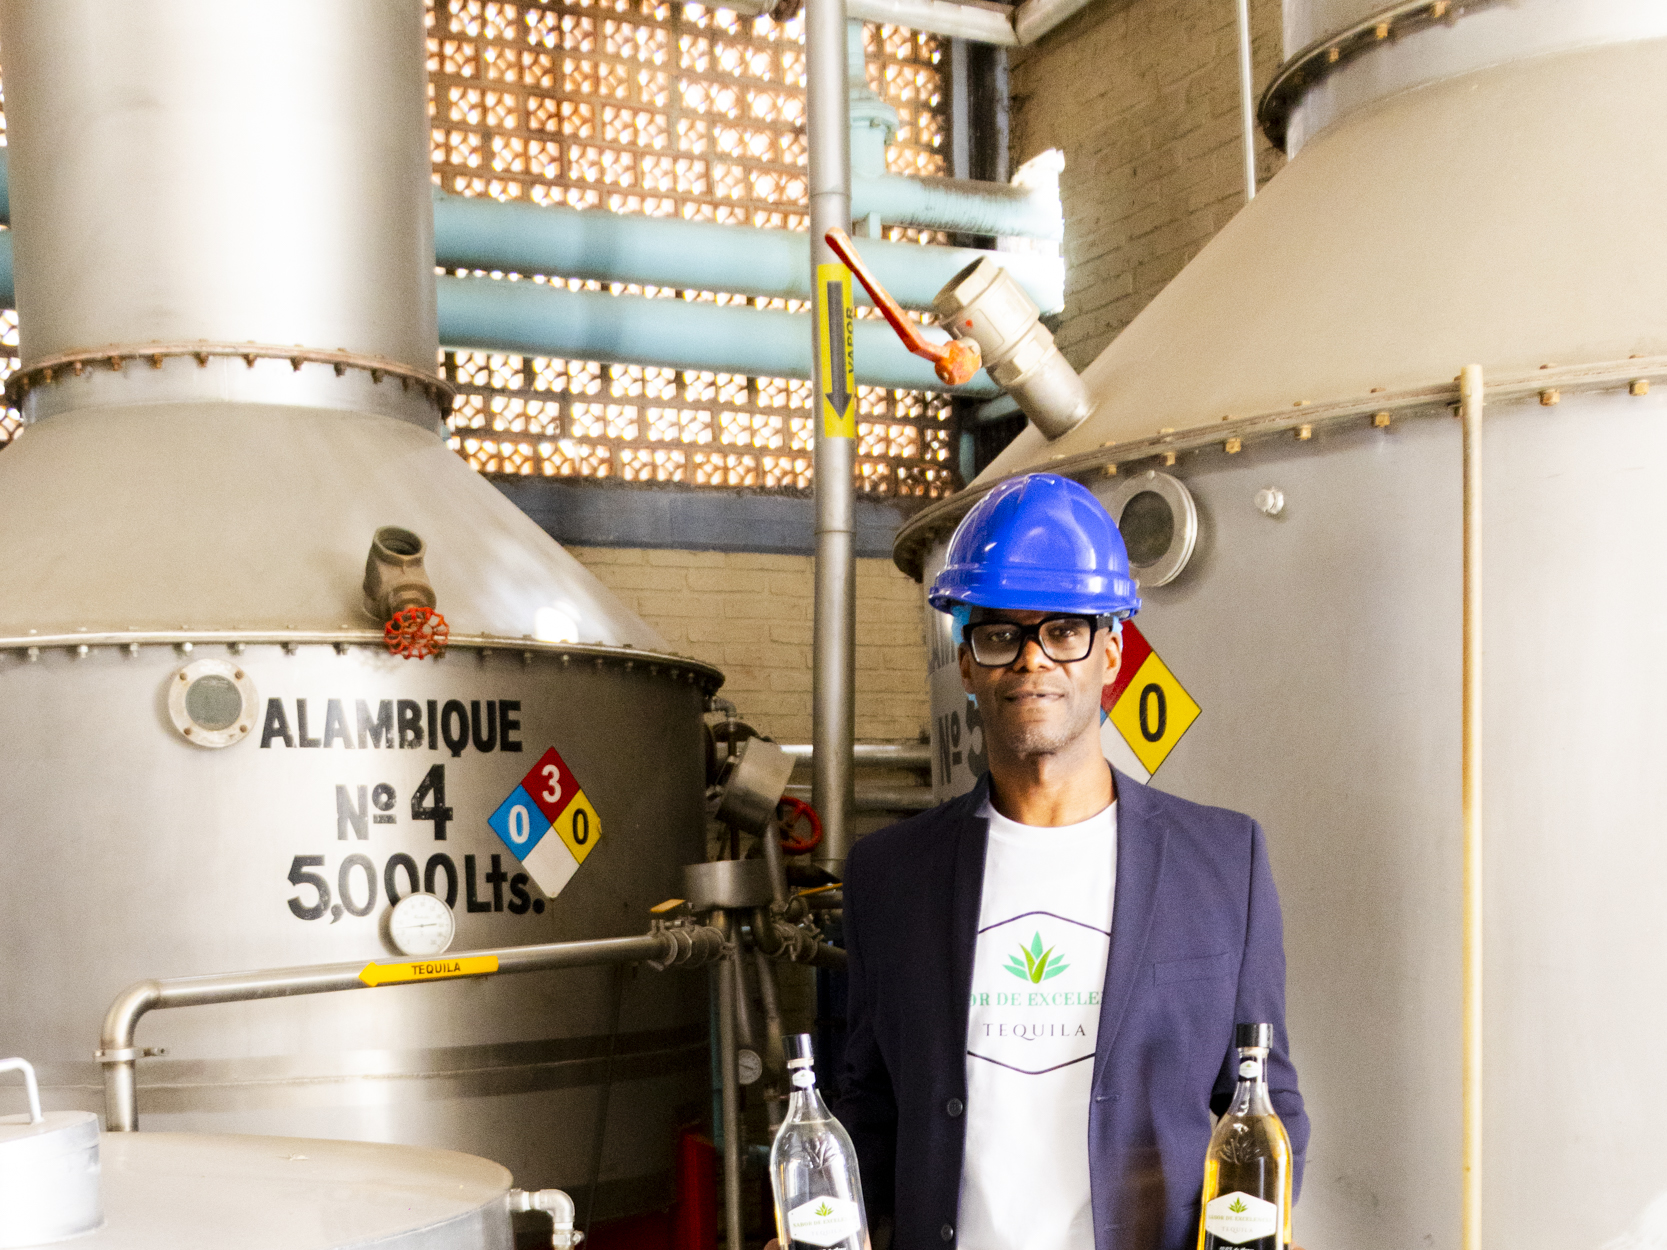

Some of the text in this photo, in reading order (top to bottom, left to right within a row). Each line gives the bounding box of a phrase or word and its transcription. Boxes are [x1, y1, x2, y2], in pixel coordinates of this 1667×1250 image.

[846, 306, 854, 374] VAPOR
[260, 697, 523, 758] ALAMBIQUE
[1139, 683, 1167, 742] 0
[410, 763, 454, 841] 4
[541, 764, 562, 803] 3
[508, 804, 530, 844] 0
[572, 808, 589, 846] 0
[411, 962, 462, 976] TEQUILA
[970, 991, 1102, 1006] OR DE EXCELE
[983, 1023, 1086, 1041] TEQUILA
